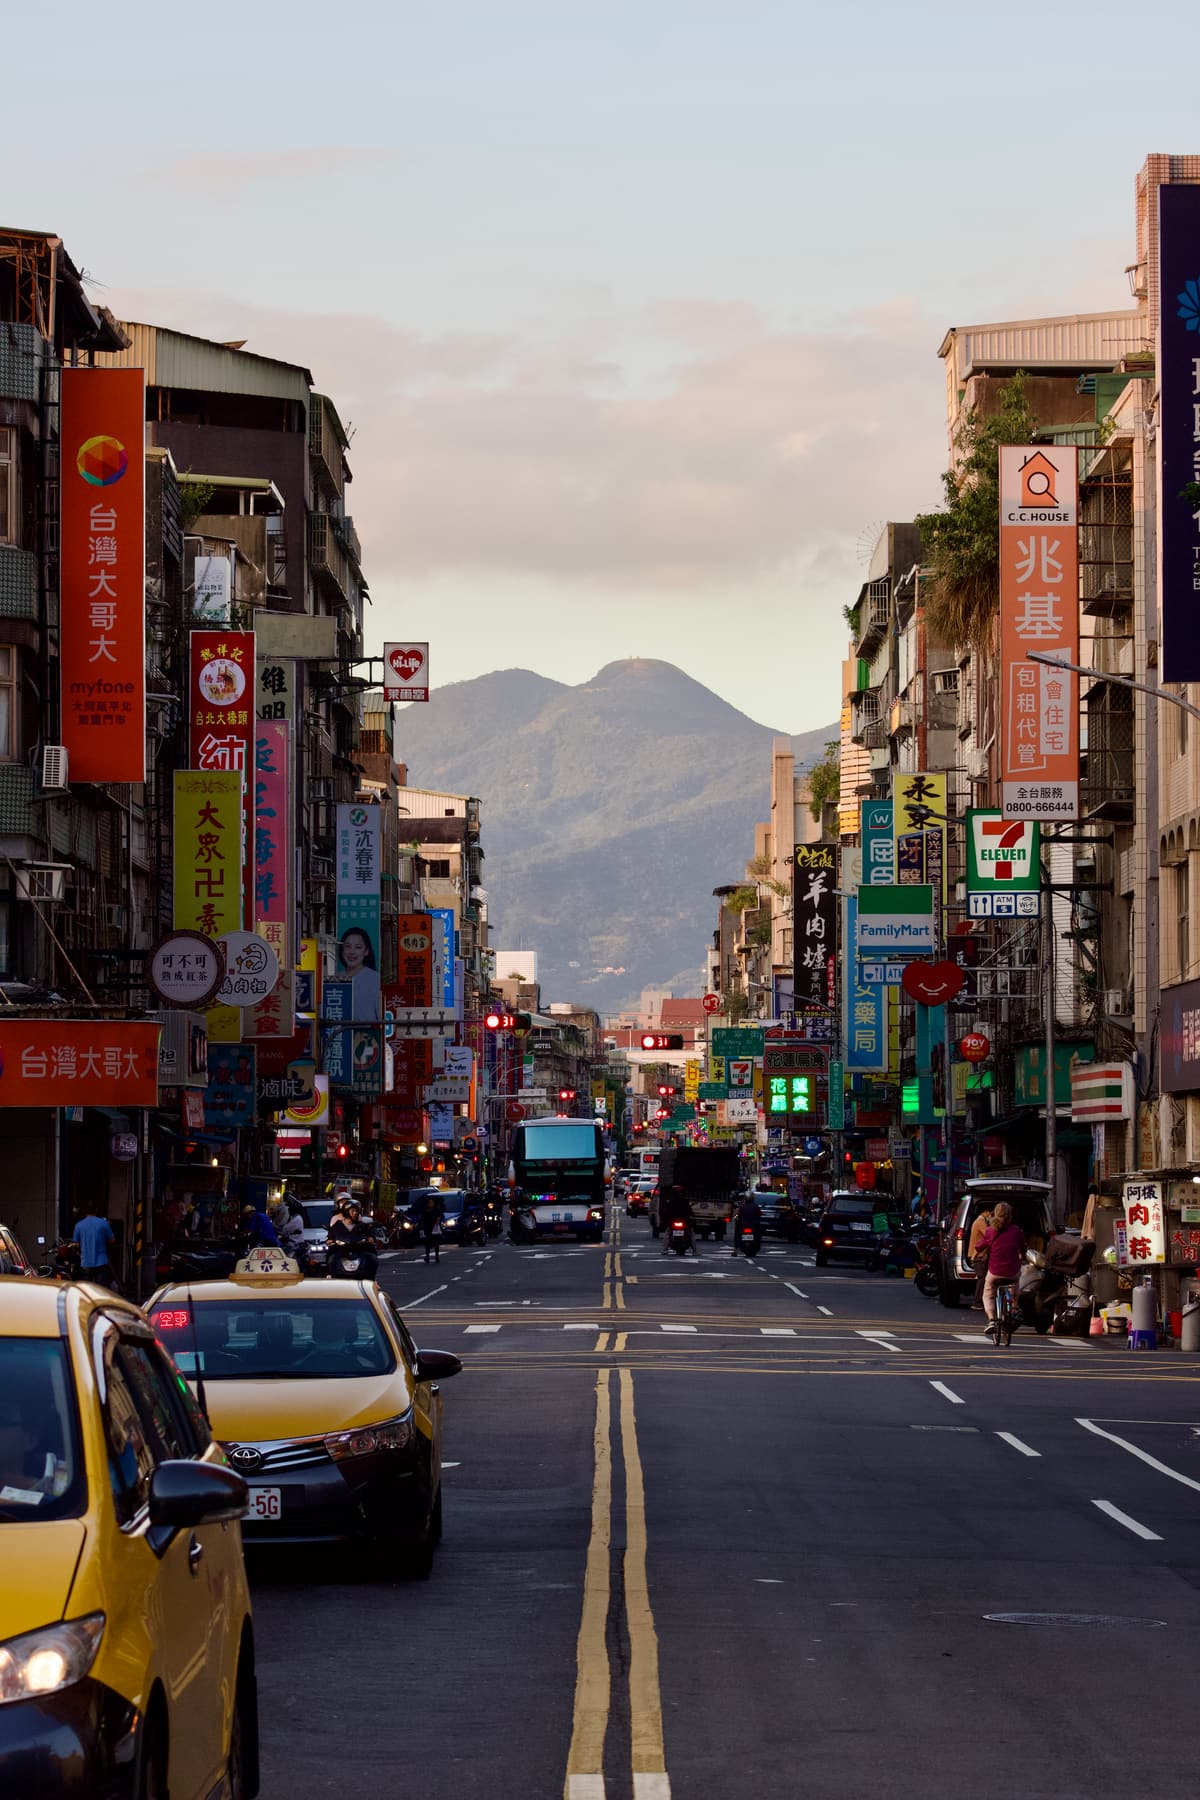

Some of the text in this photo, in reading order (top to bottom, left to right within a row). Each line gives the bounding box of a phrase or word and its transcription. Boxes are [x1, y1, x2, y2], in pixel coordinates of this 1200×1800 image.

[1008, 512, 1070, 522] C.C.HOUSE
[88, 503, 118, 664] 台灣大哥大
[1015, 535, 1064, 640] 兆基
[70, 679, 134, 697] myfone
[1044, 653, 1064, 751] 社會住宅
[196, 710, 248, 726] 台北大橋頭
[1016, 667, 1037, 764] 包租代管
[1017, 787, 1064, 800] 全台服務
[1006, 801, 1074, 814] 0800-666444
[356, 830, 373, 884] 沈春華
[802, 870, 828, 969] 羊肉爐
[861, 924, 929, 938] FamilyMart
[160, 954, 208, 969] 可不可
[161, 971, 208, 981] 熟成紅茶
[503, 1016, 514, 1027] 31
[657, 1037, 668, 1046] 31
[966, 1038, 985, 1048] JOY
[21, 1045, 140, 1080] 台灣大哥大
